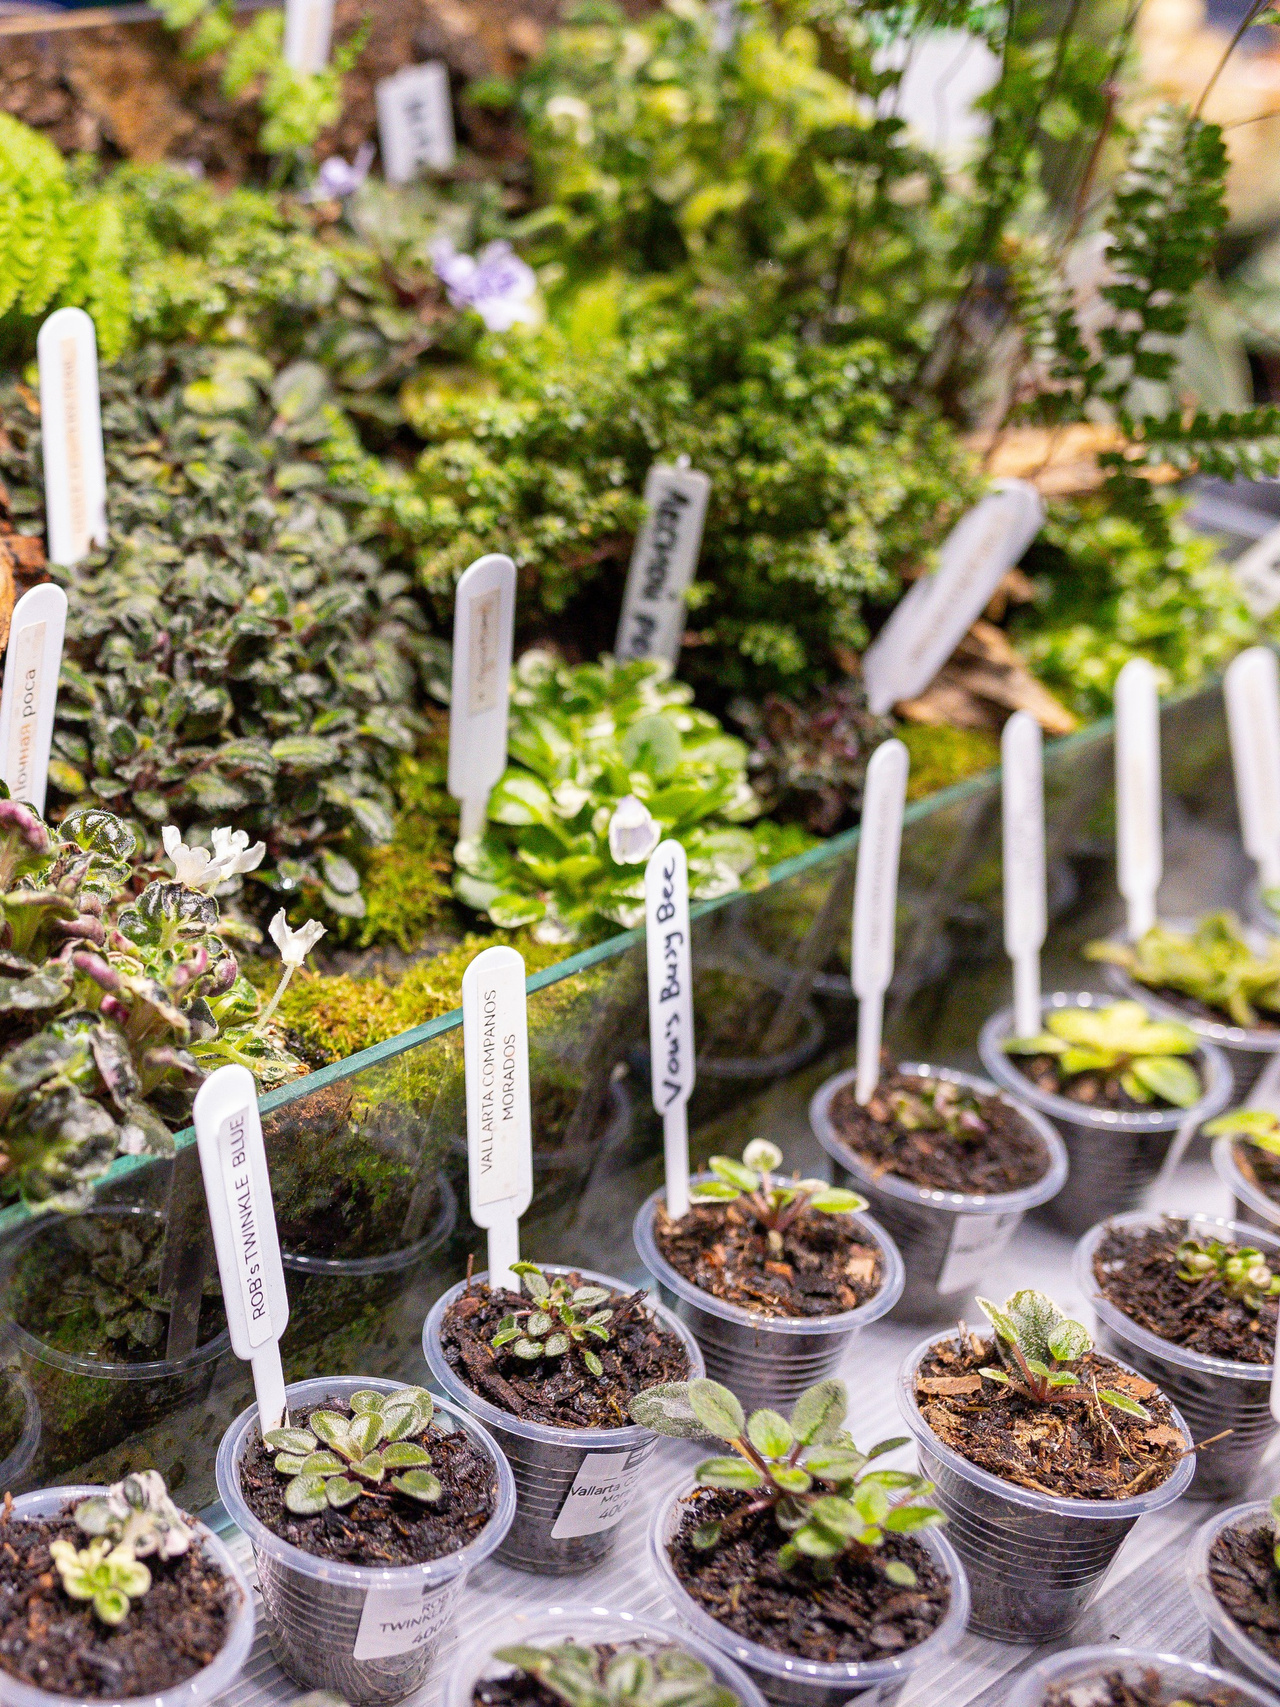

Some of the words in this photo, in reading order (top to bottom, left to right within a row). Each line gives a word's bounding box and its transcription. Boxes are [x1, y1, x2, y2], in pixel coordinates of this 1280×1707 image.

[21, 668, 37, 719] роса
[656, 857, 676, 925] Bee
[659, 931, 684, 1004] Busy
[482, 988, 497, 1088] COMPANOS
[502, 1033, 516, 1122] MORADOS
[229, 1114, 247, 1168] BLUE
[480, 1090, 494, 1175] VALLARTA
[234, 1173, 258, 1265] TWINKLE
[246, 1263, 267, 1321] ROB's
[571, 1483, 621, 1497] Vallarta
